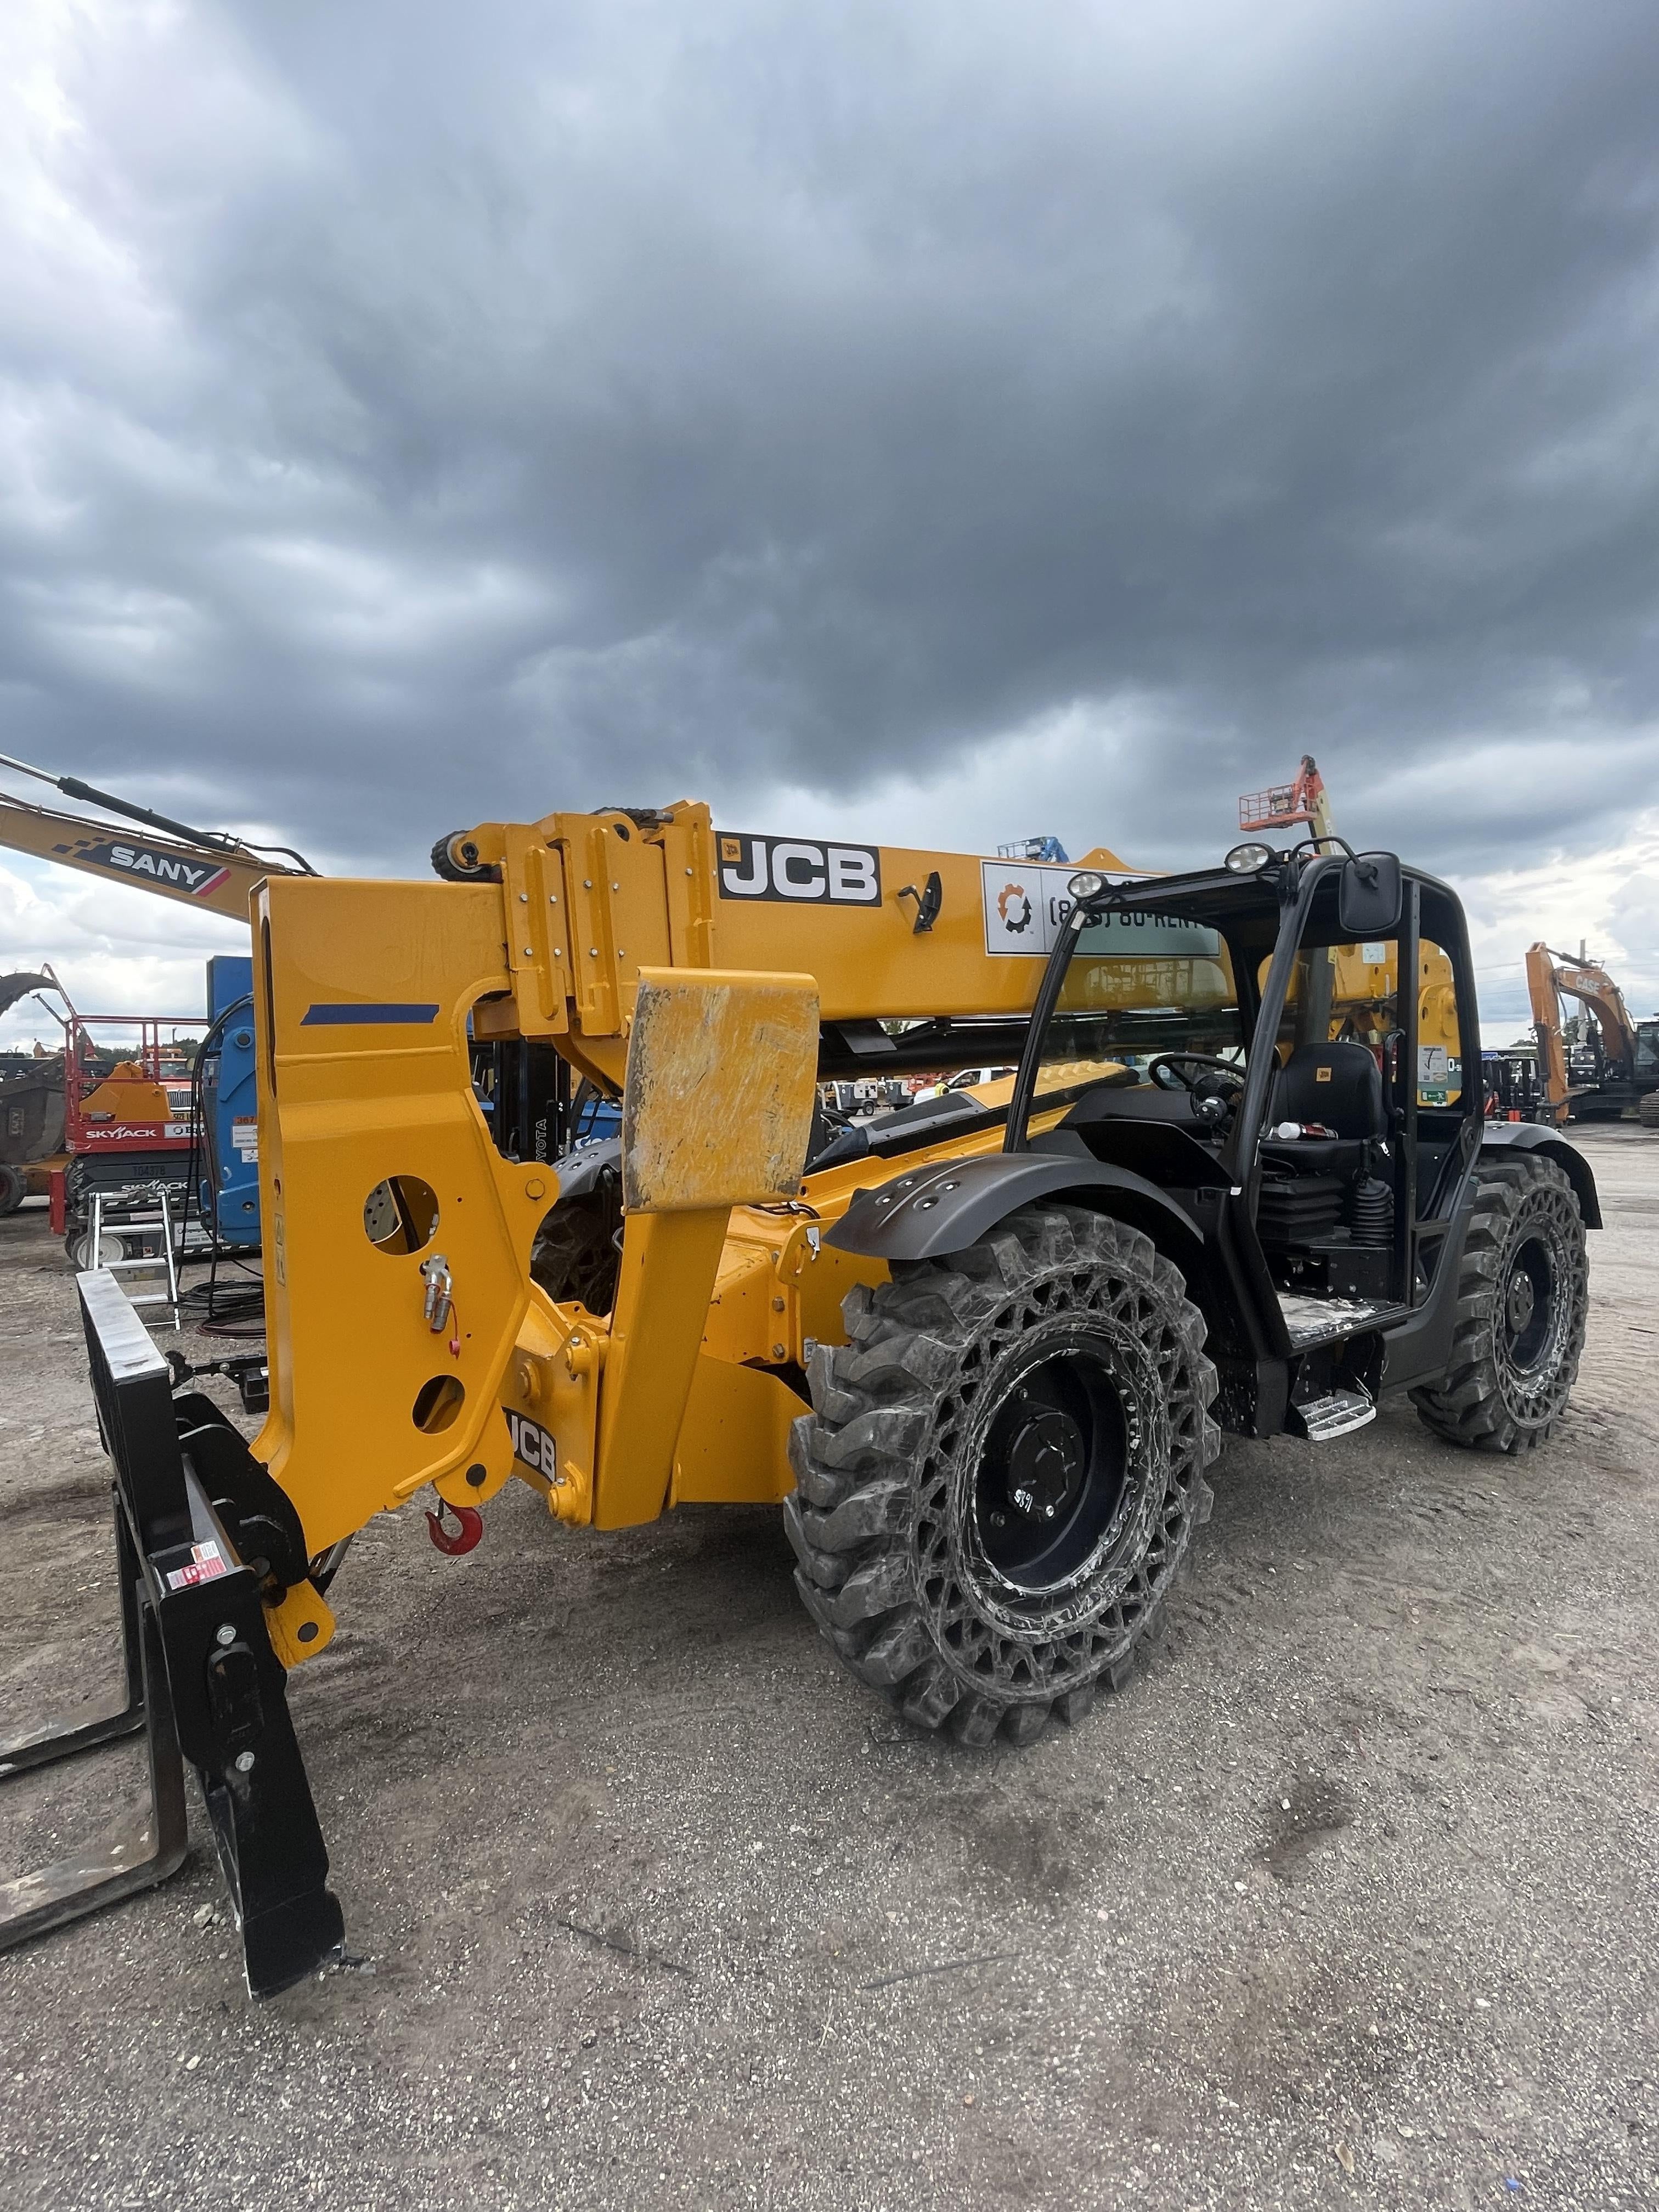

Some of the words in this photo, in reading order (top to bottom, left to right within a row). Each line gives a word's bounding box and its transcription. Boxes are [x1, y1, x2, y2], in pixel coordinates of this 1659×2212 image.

[110, 846, 205, 885] SANY
[723, 841, 878, 901] JCB
[1576, 975, 1600, 996] CASE
[86, 1126, 157, 1139] SKYJACK
[535, 1119, 546, 1163] YOTA
[511, 1415, 556, 1483] JCB
